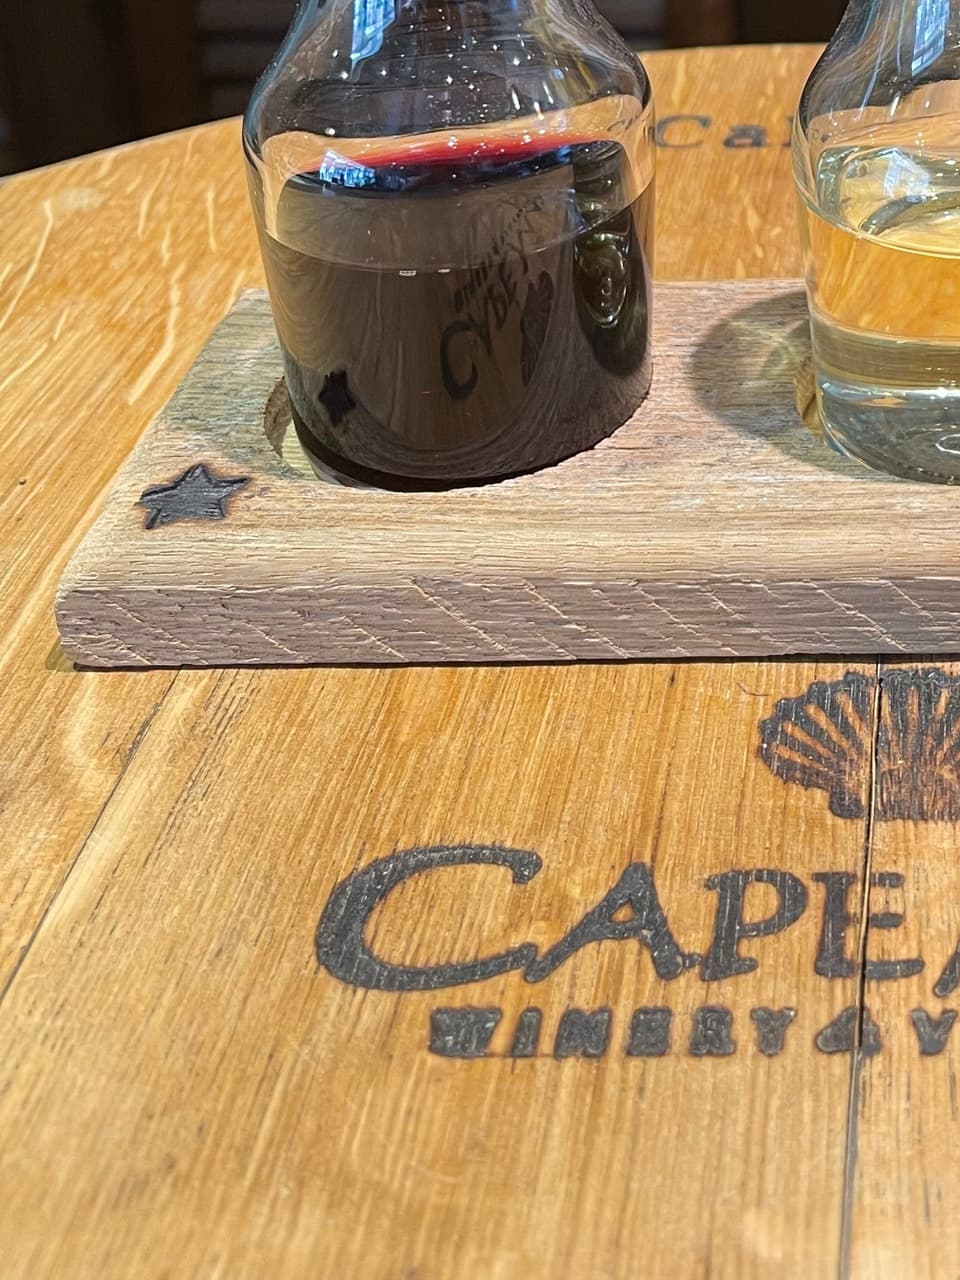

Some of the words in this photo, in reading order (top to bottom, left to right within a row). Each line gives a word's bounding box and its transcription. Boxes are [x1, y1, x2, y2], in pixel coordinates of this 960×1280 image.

[653, 113, 793, 148] Ca
[315, 843, 925, 991] CAPE
[428, 1006, 796, 1058] WINERY
